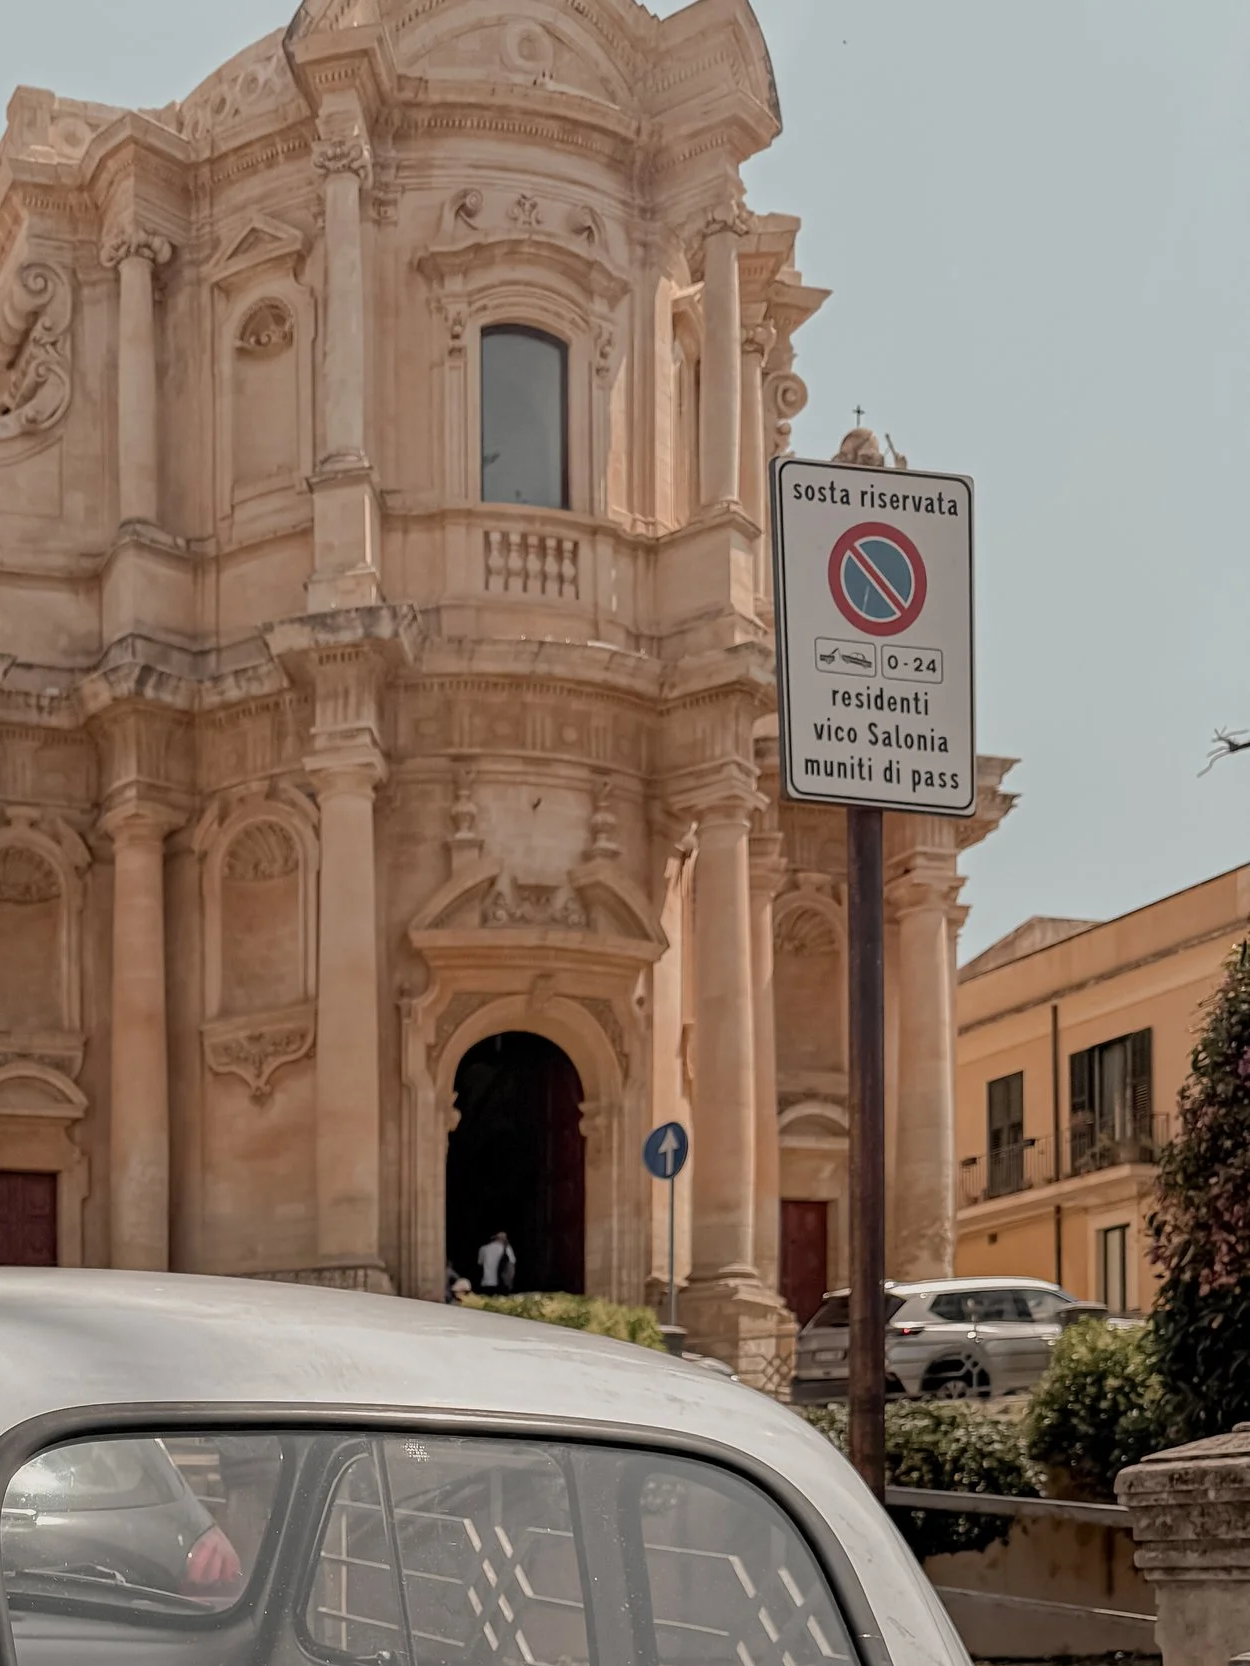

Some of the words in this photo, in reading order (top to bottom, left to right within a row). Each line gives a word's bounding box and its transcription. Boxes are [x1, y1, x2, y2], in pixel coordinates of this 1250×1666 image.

[793, 480, 851, 506] sosta
[860, 484, 958, 516] riservata
[914, 657, 937, 673] 24
[832, 686, 929, 716] residenti
[813, 717, 858, 744] vico
[868, 722, 949, 753] Salonia
[804, 755, 873, 782] muniti
[883, 760, 901, 785] di
[911, 770, 959, 792] pass
